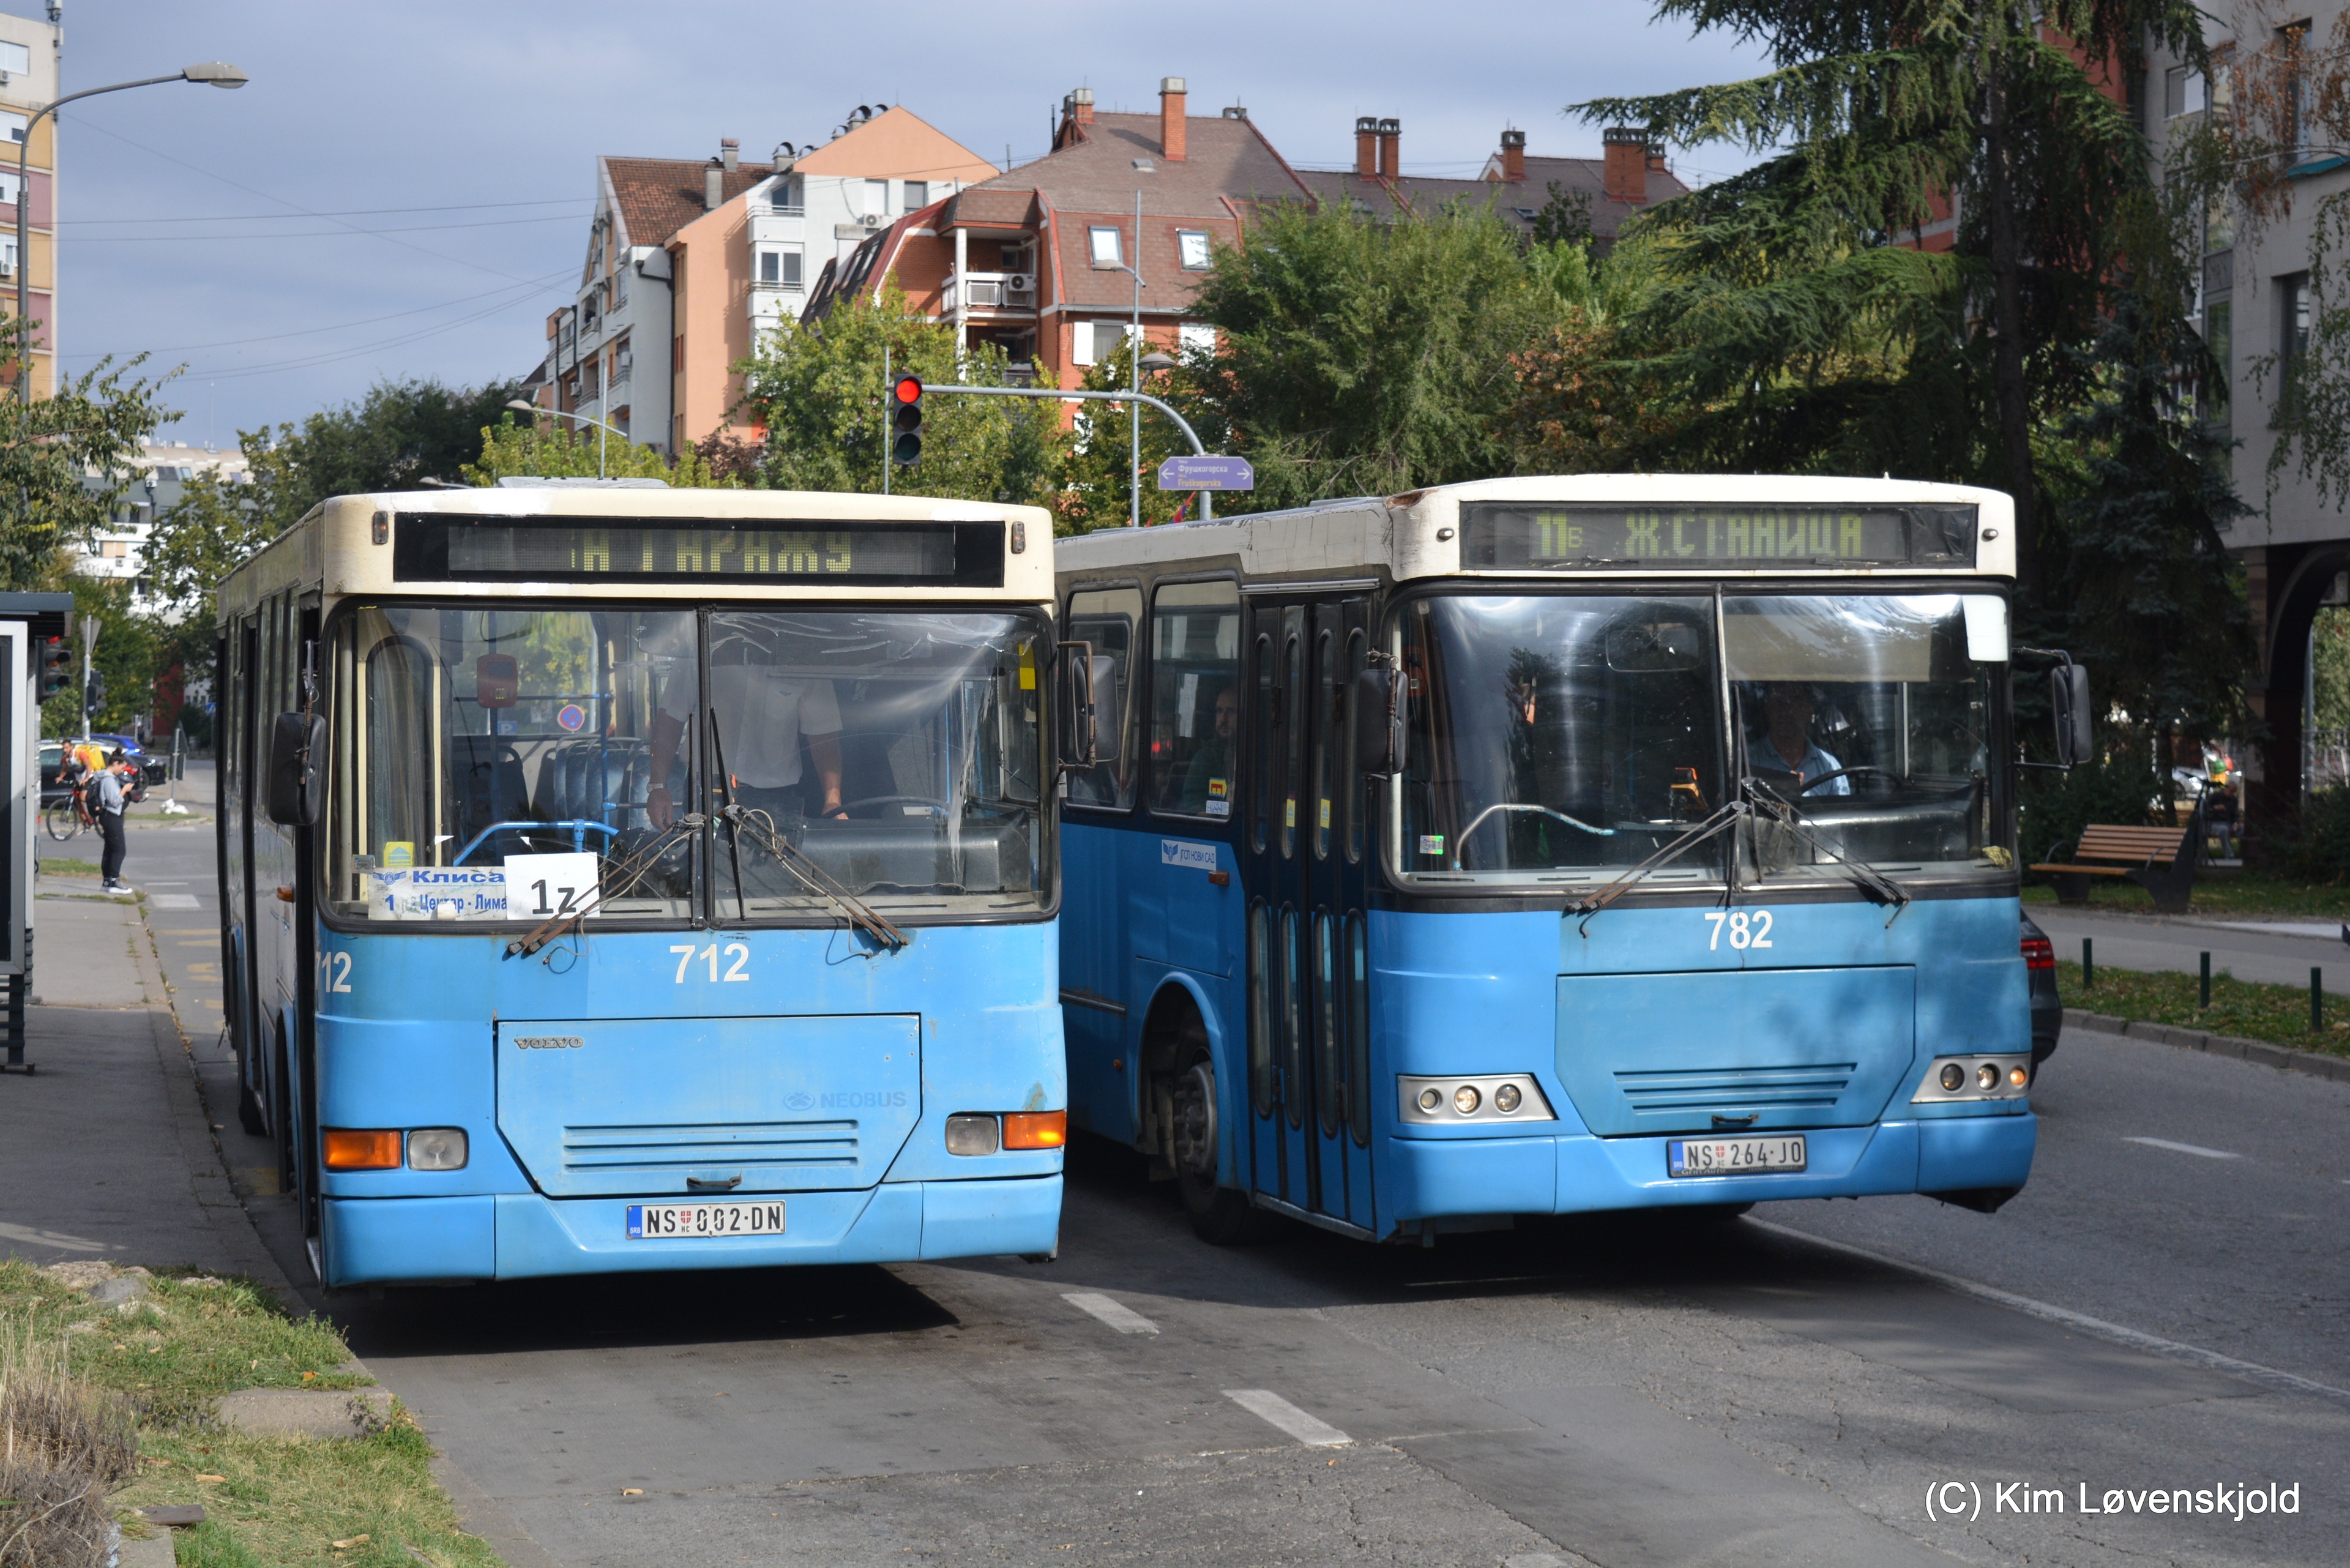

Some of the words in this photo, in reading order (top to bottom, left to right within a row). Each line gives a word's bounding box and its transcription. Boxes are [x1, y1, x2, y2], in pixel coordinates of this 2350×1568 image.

[1178, 465, 1228, 474] Фрушкогорска
[1178, 479, 1222, 488] Fruškogorska
[1190, 849, 1204, 862] НОВИ
[1204, 853, 1215, 864] САД
[412, 870, 505, 883] Клиса
[384, 895, 394, 911] 1
[1704, 910, 1773, 950] 782
[670, 944, 749, 984] 712
[514, 1037, 584, 1049] VOLVO
[820, 1091, 906, 1108] NEOBUS
[1687, 1145, 1712, 1167] NS
[647, 1209, 676, 1233] NS
